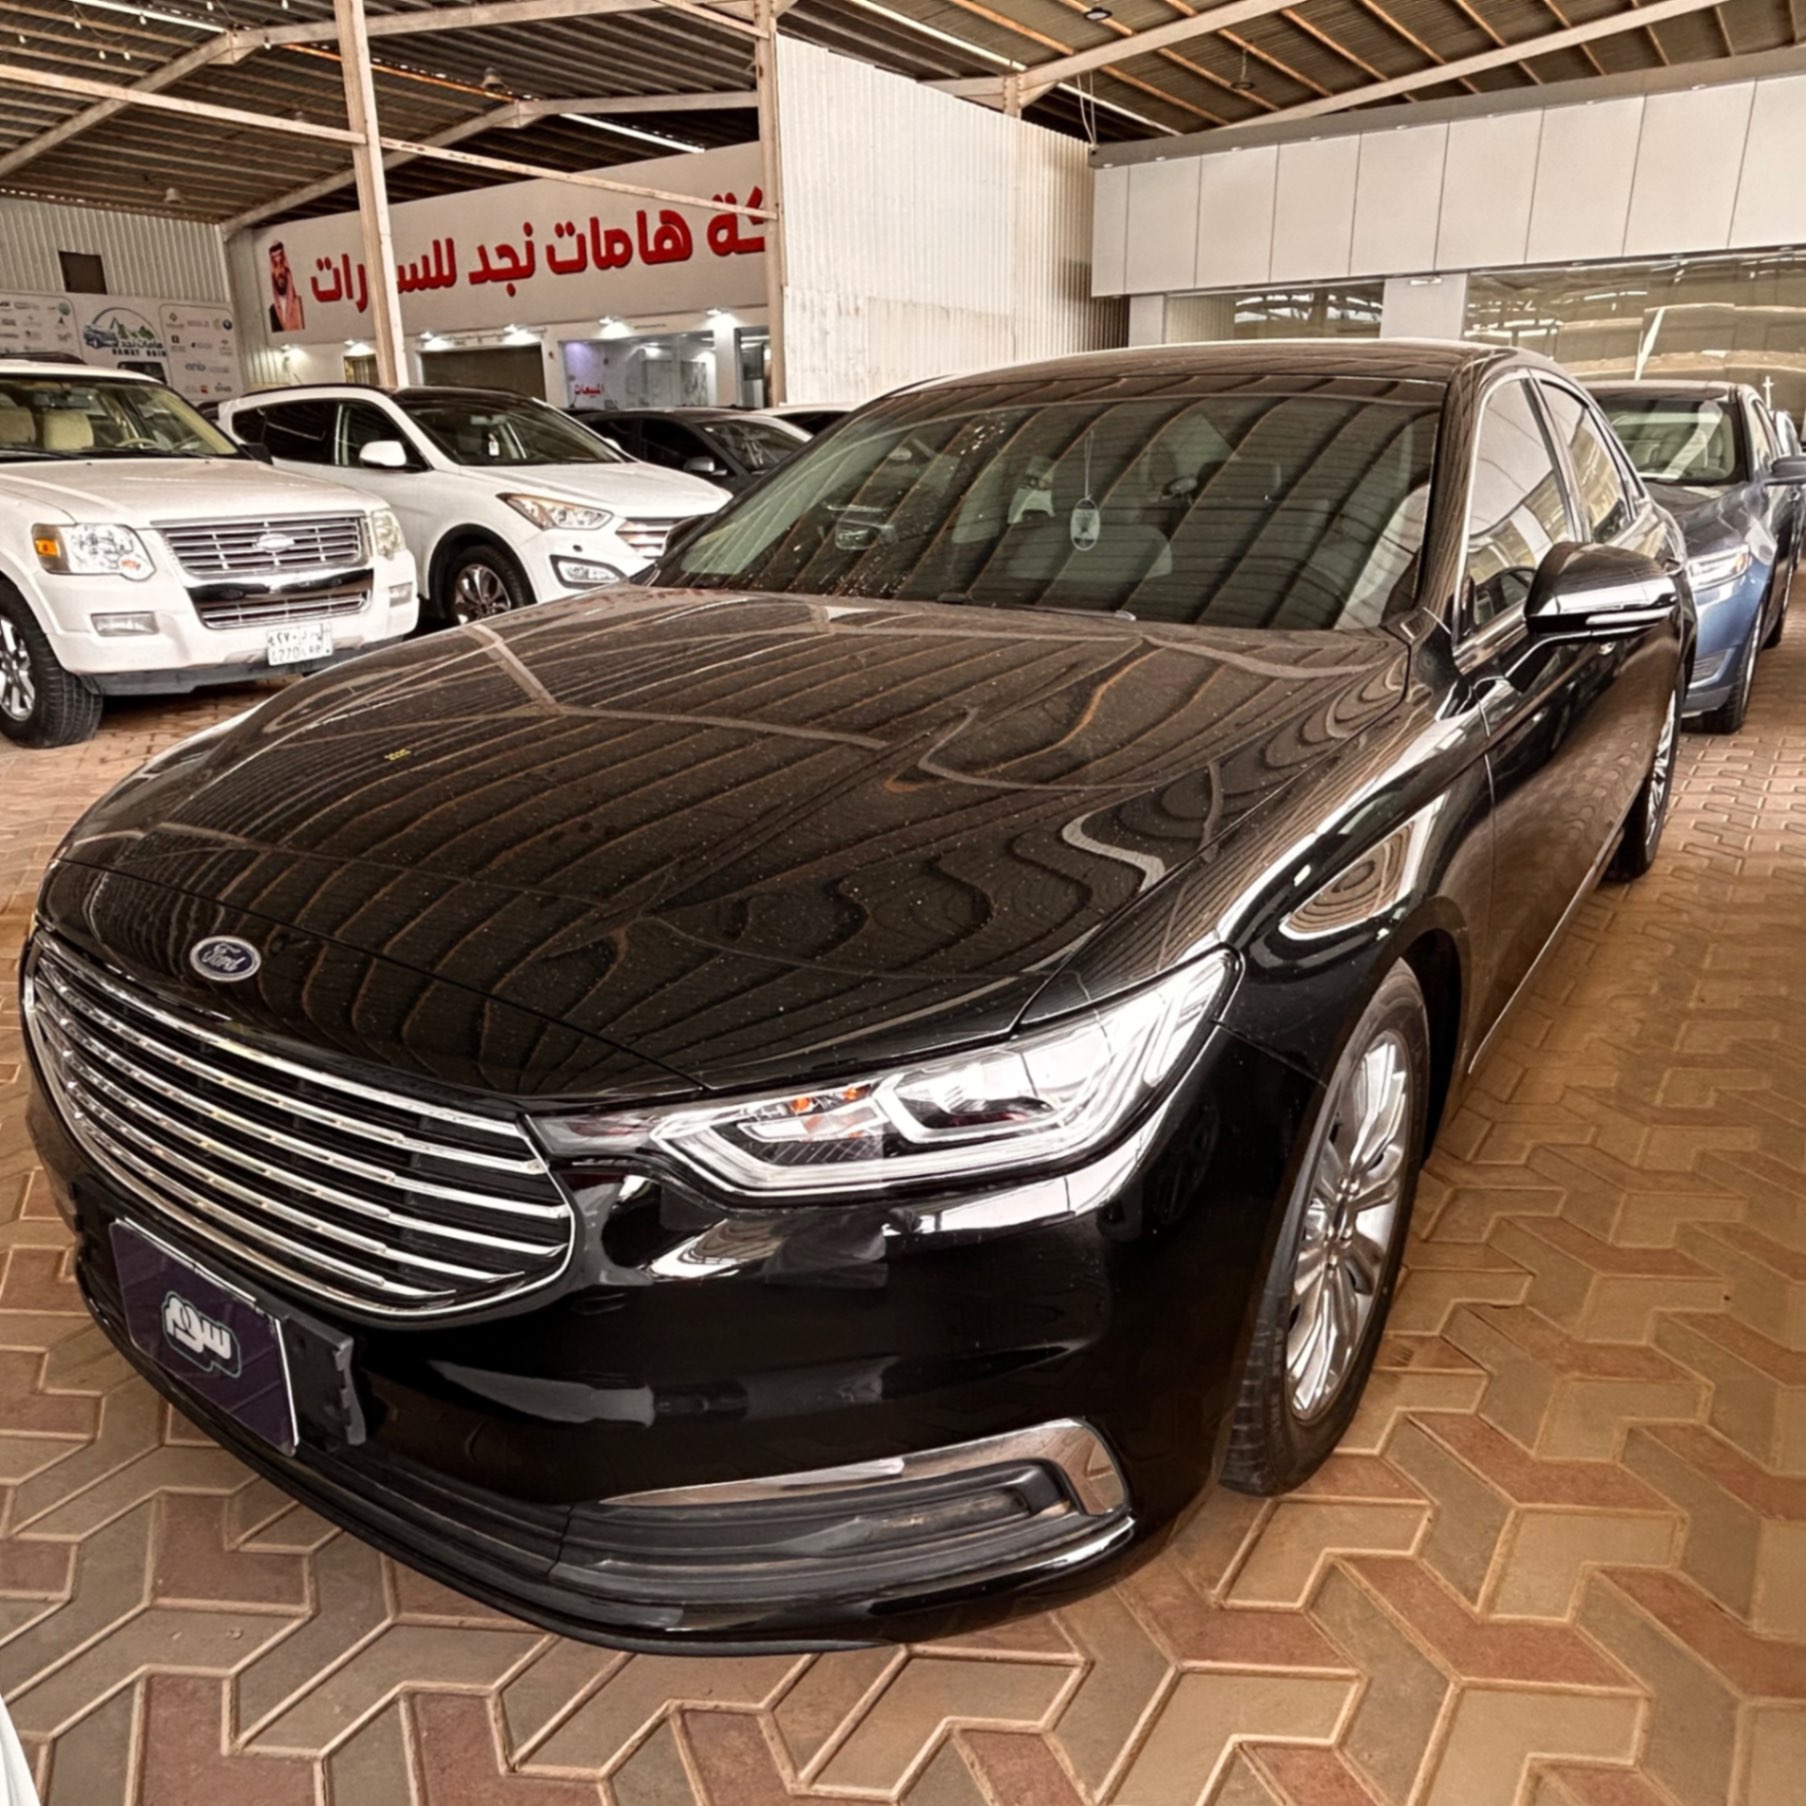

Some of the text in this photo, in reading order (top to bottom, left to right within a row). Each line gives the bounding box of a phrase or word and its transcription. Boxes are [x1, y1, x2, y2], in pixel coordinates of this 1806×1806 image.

[310, 185, 766, 314] كة هامات نجد للسرات
[201, 942, 247, 972] Ford
